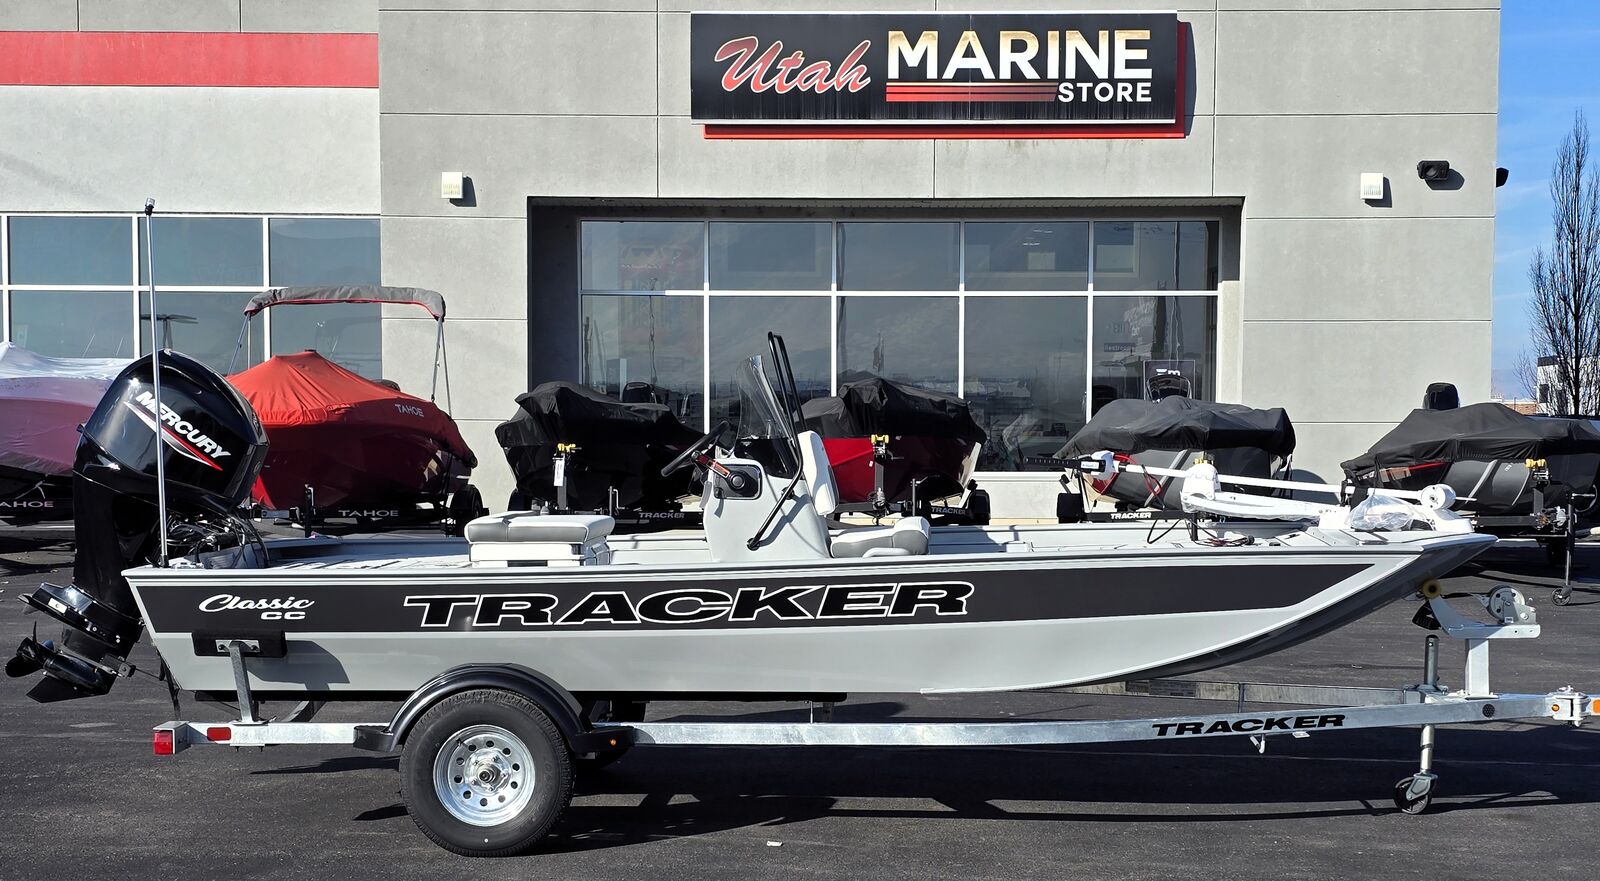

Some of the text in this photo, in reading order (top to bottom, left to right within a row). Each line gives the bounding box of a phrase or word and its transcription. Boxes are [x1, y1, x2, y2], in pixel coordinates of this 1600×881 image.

[714, 30, 1153, 94] Utah MARINE
[1057, 81, 1153, 103] STORE
[394, 403, 425, 418] TAHOE
[135, 390, 231, 459] MERCURY
[338, 509, 399, 517] TAHOE
[931, 506, 967, 515] TRACKER
[199, 594, 315, 612] Classic
[404, 581, 975, 627] TRACKER
[261, 612, 306, 620] CC
[1152, 714, 1346, 736] TRACKER
